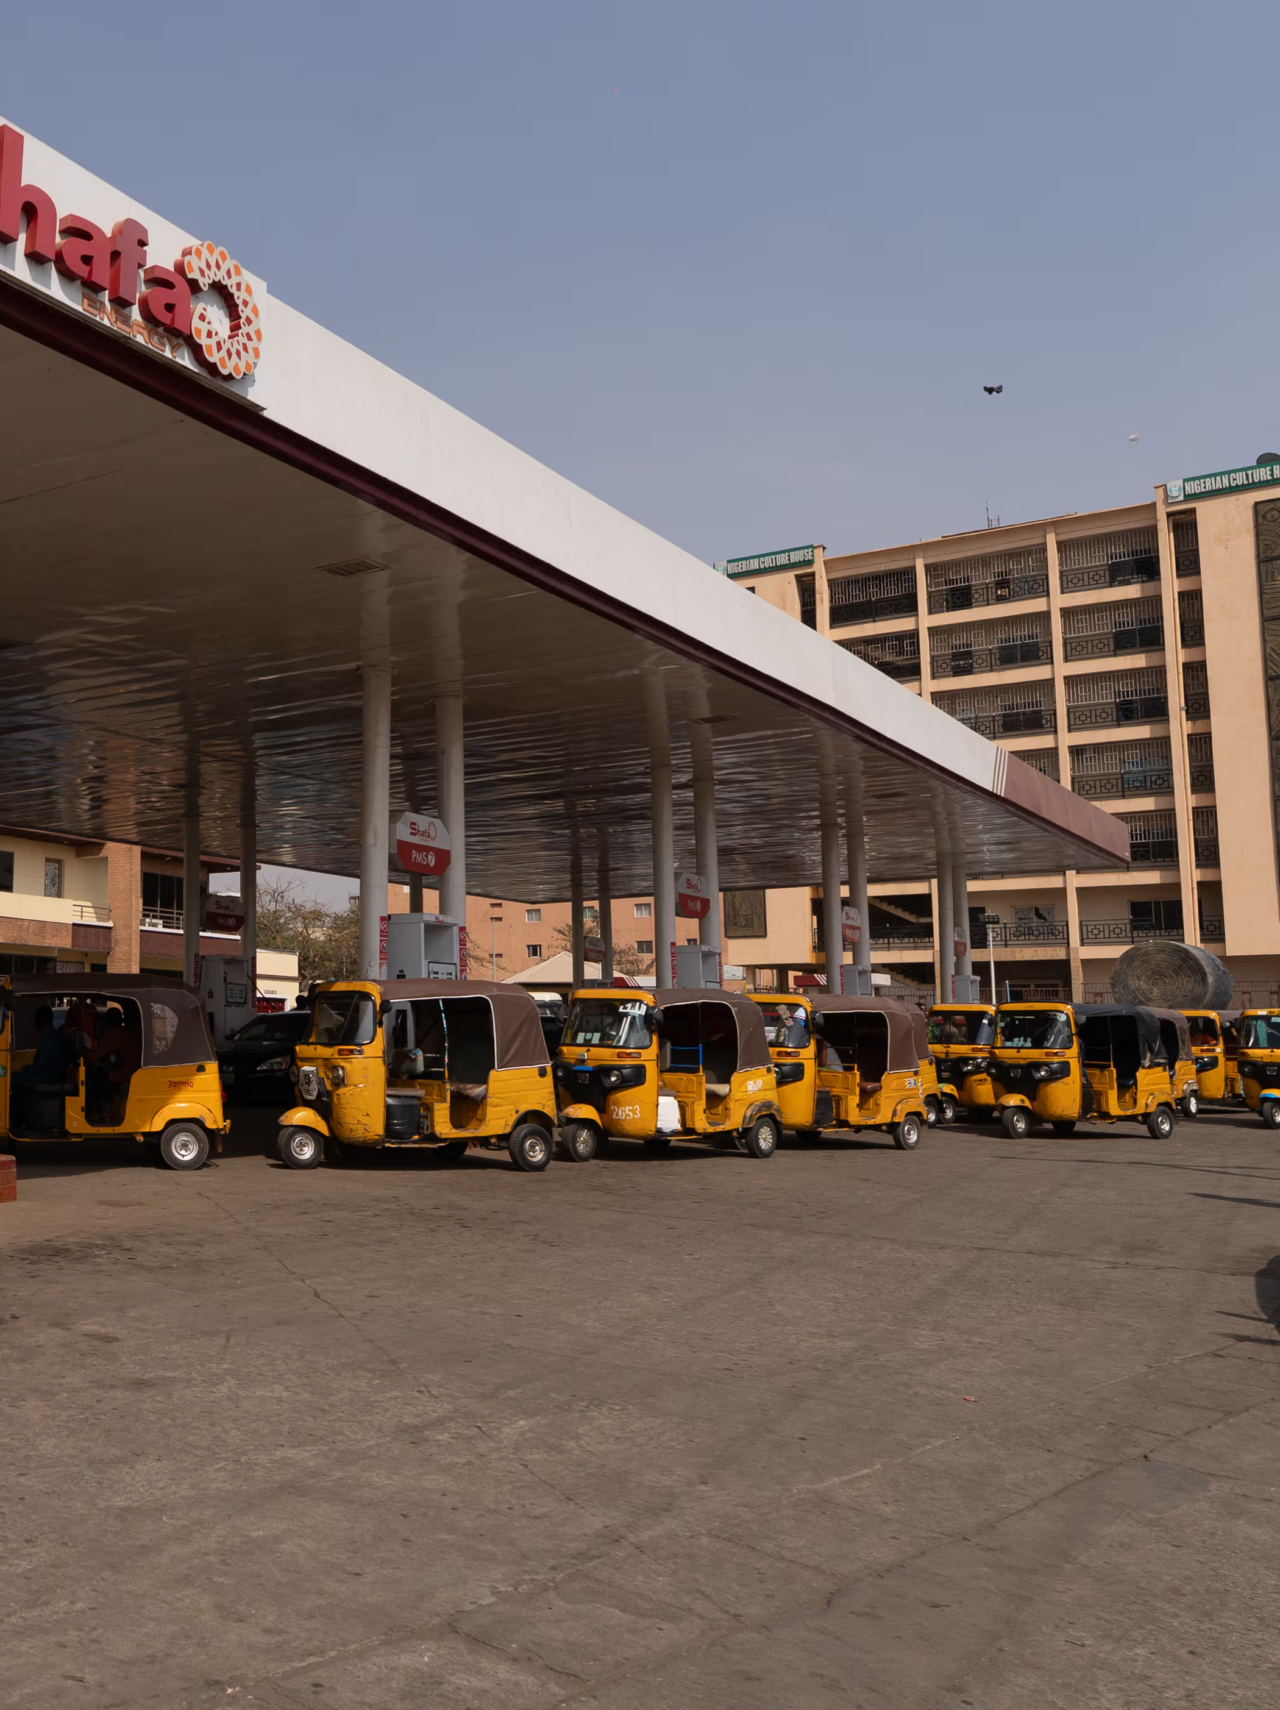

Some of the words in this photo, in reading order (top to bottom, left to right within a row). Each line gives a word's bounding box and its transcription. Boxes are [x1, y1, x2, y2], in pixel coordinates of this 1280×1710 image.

[81, 291, 185, 360] ENERGY
[1184, 474, 1229, 495] NIGERIAN
[1230, 467, 1272, 487] CULTURE
[727, 558, 759, 574] NIGERIAN
[760, 552, 790, 569] CULTURE
[790, 548, 813, 563] HOUSE
[409, 821, 431, 838] Shafa
[412, 850, 427, 865] PMS
[611, 1105, 640, 1119] 2653
